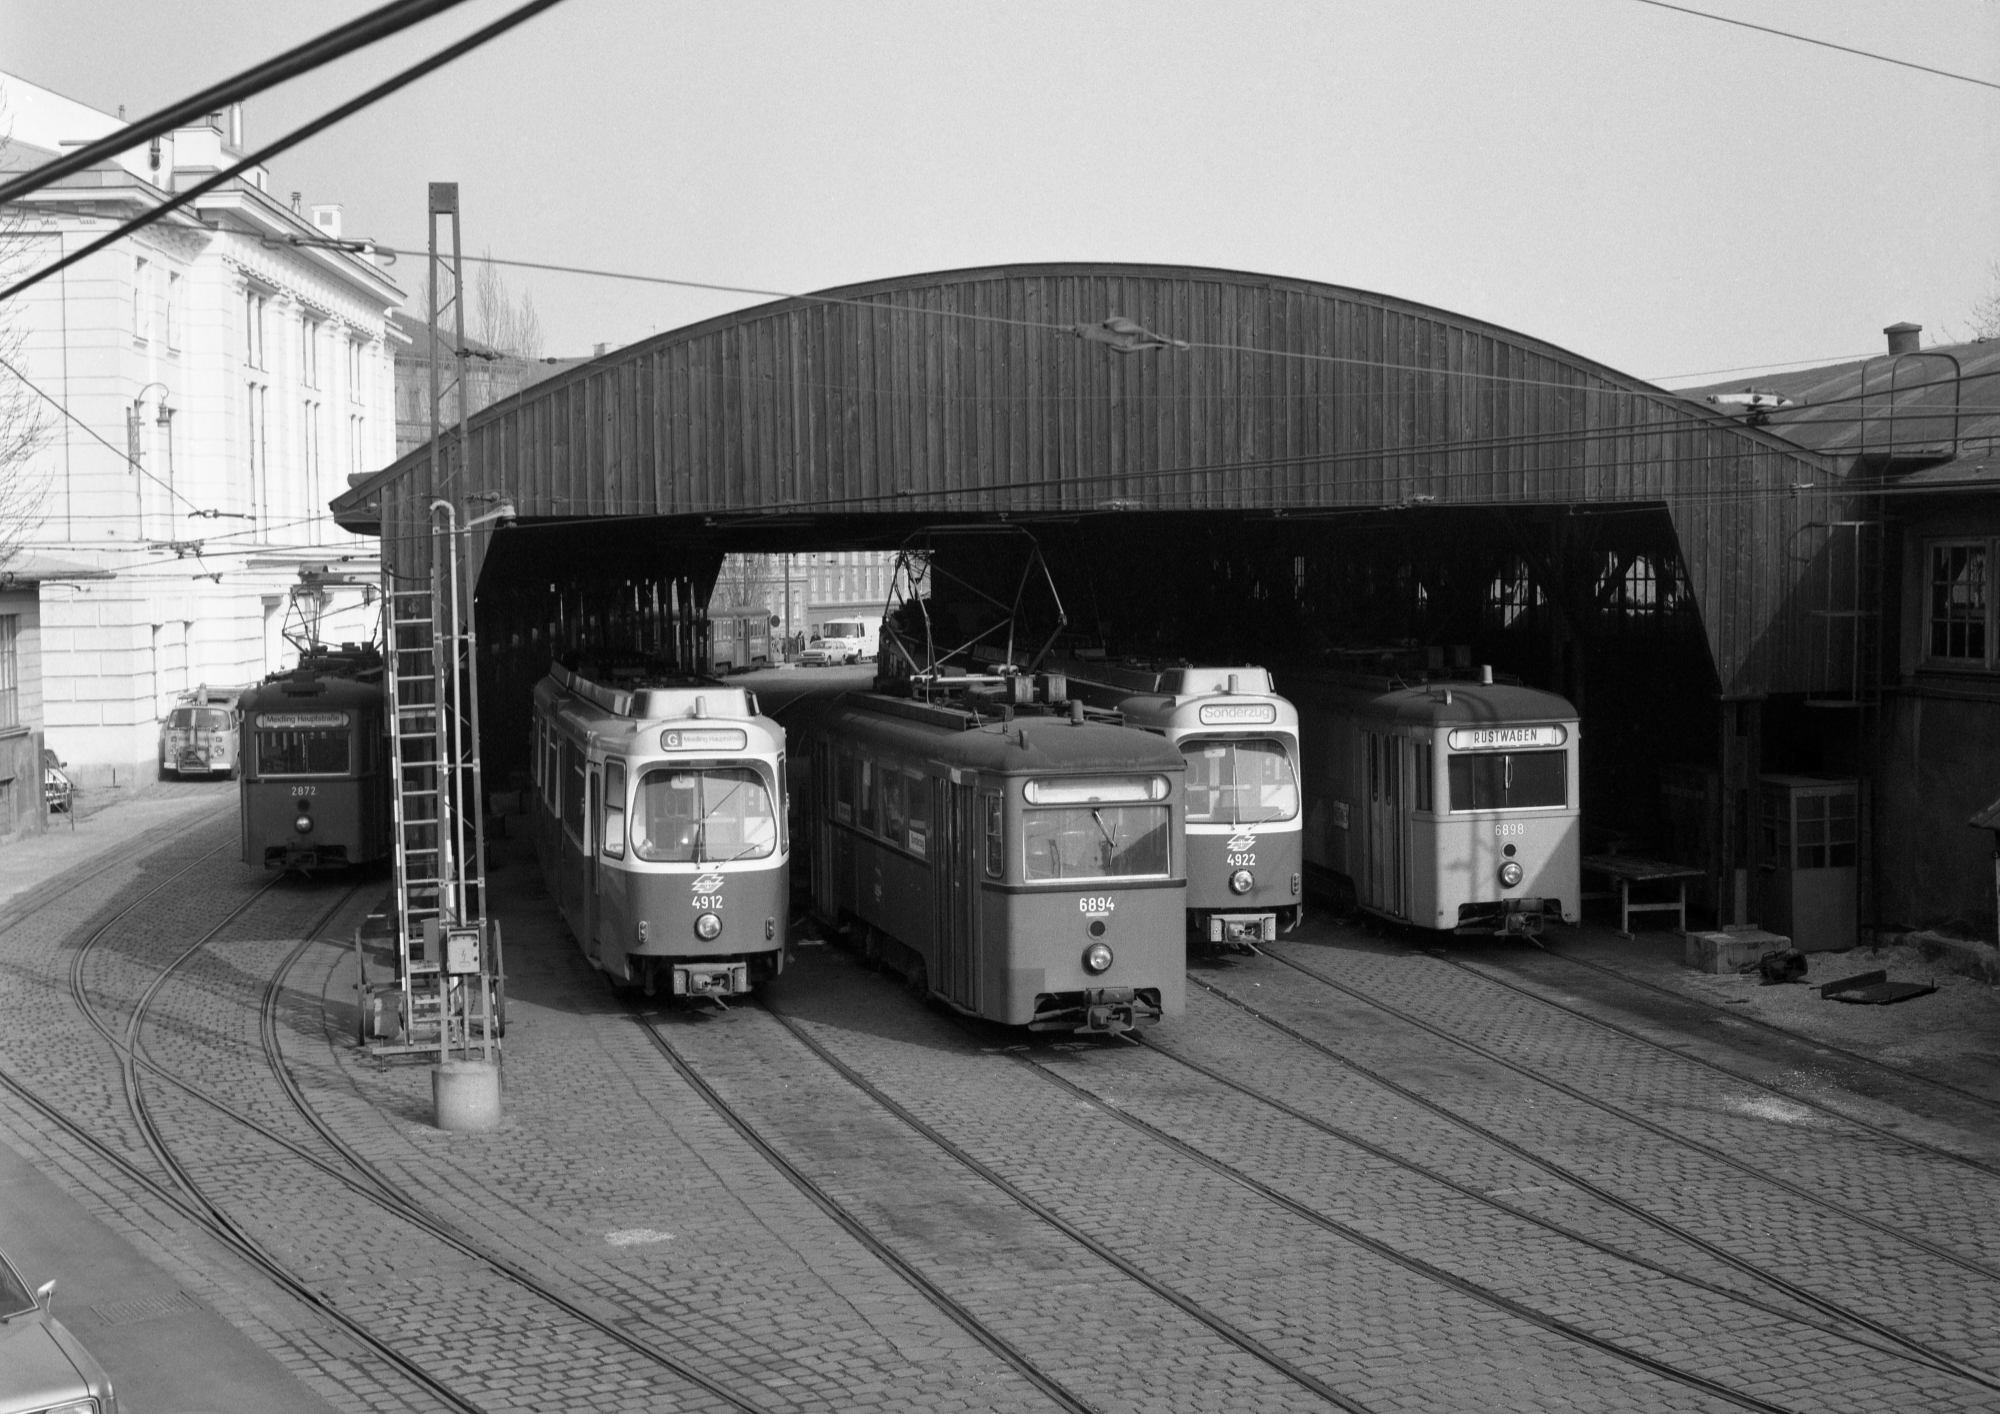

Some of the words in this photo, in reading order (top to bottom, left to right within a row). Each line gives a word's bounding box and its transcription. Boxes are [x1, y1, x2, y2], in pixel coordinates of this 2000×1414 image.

[267, 715, 296, 724] Meidling
[297, 714, 340, 723] Hauptstraße
[1204, 706, 1270, 719] Sonderzug
[667, 733, 679, 746] G
[1474, 729, 1538, 743] RÜSTWAGEN
[291, 786, 316, 796] 2872
[1495, 823, 1524, 835] 6898
[1226, 853, 1256, 866] 4922
[691, 895, 724, 909] 4912
[1079, 897, 1115, 912] 6894
